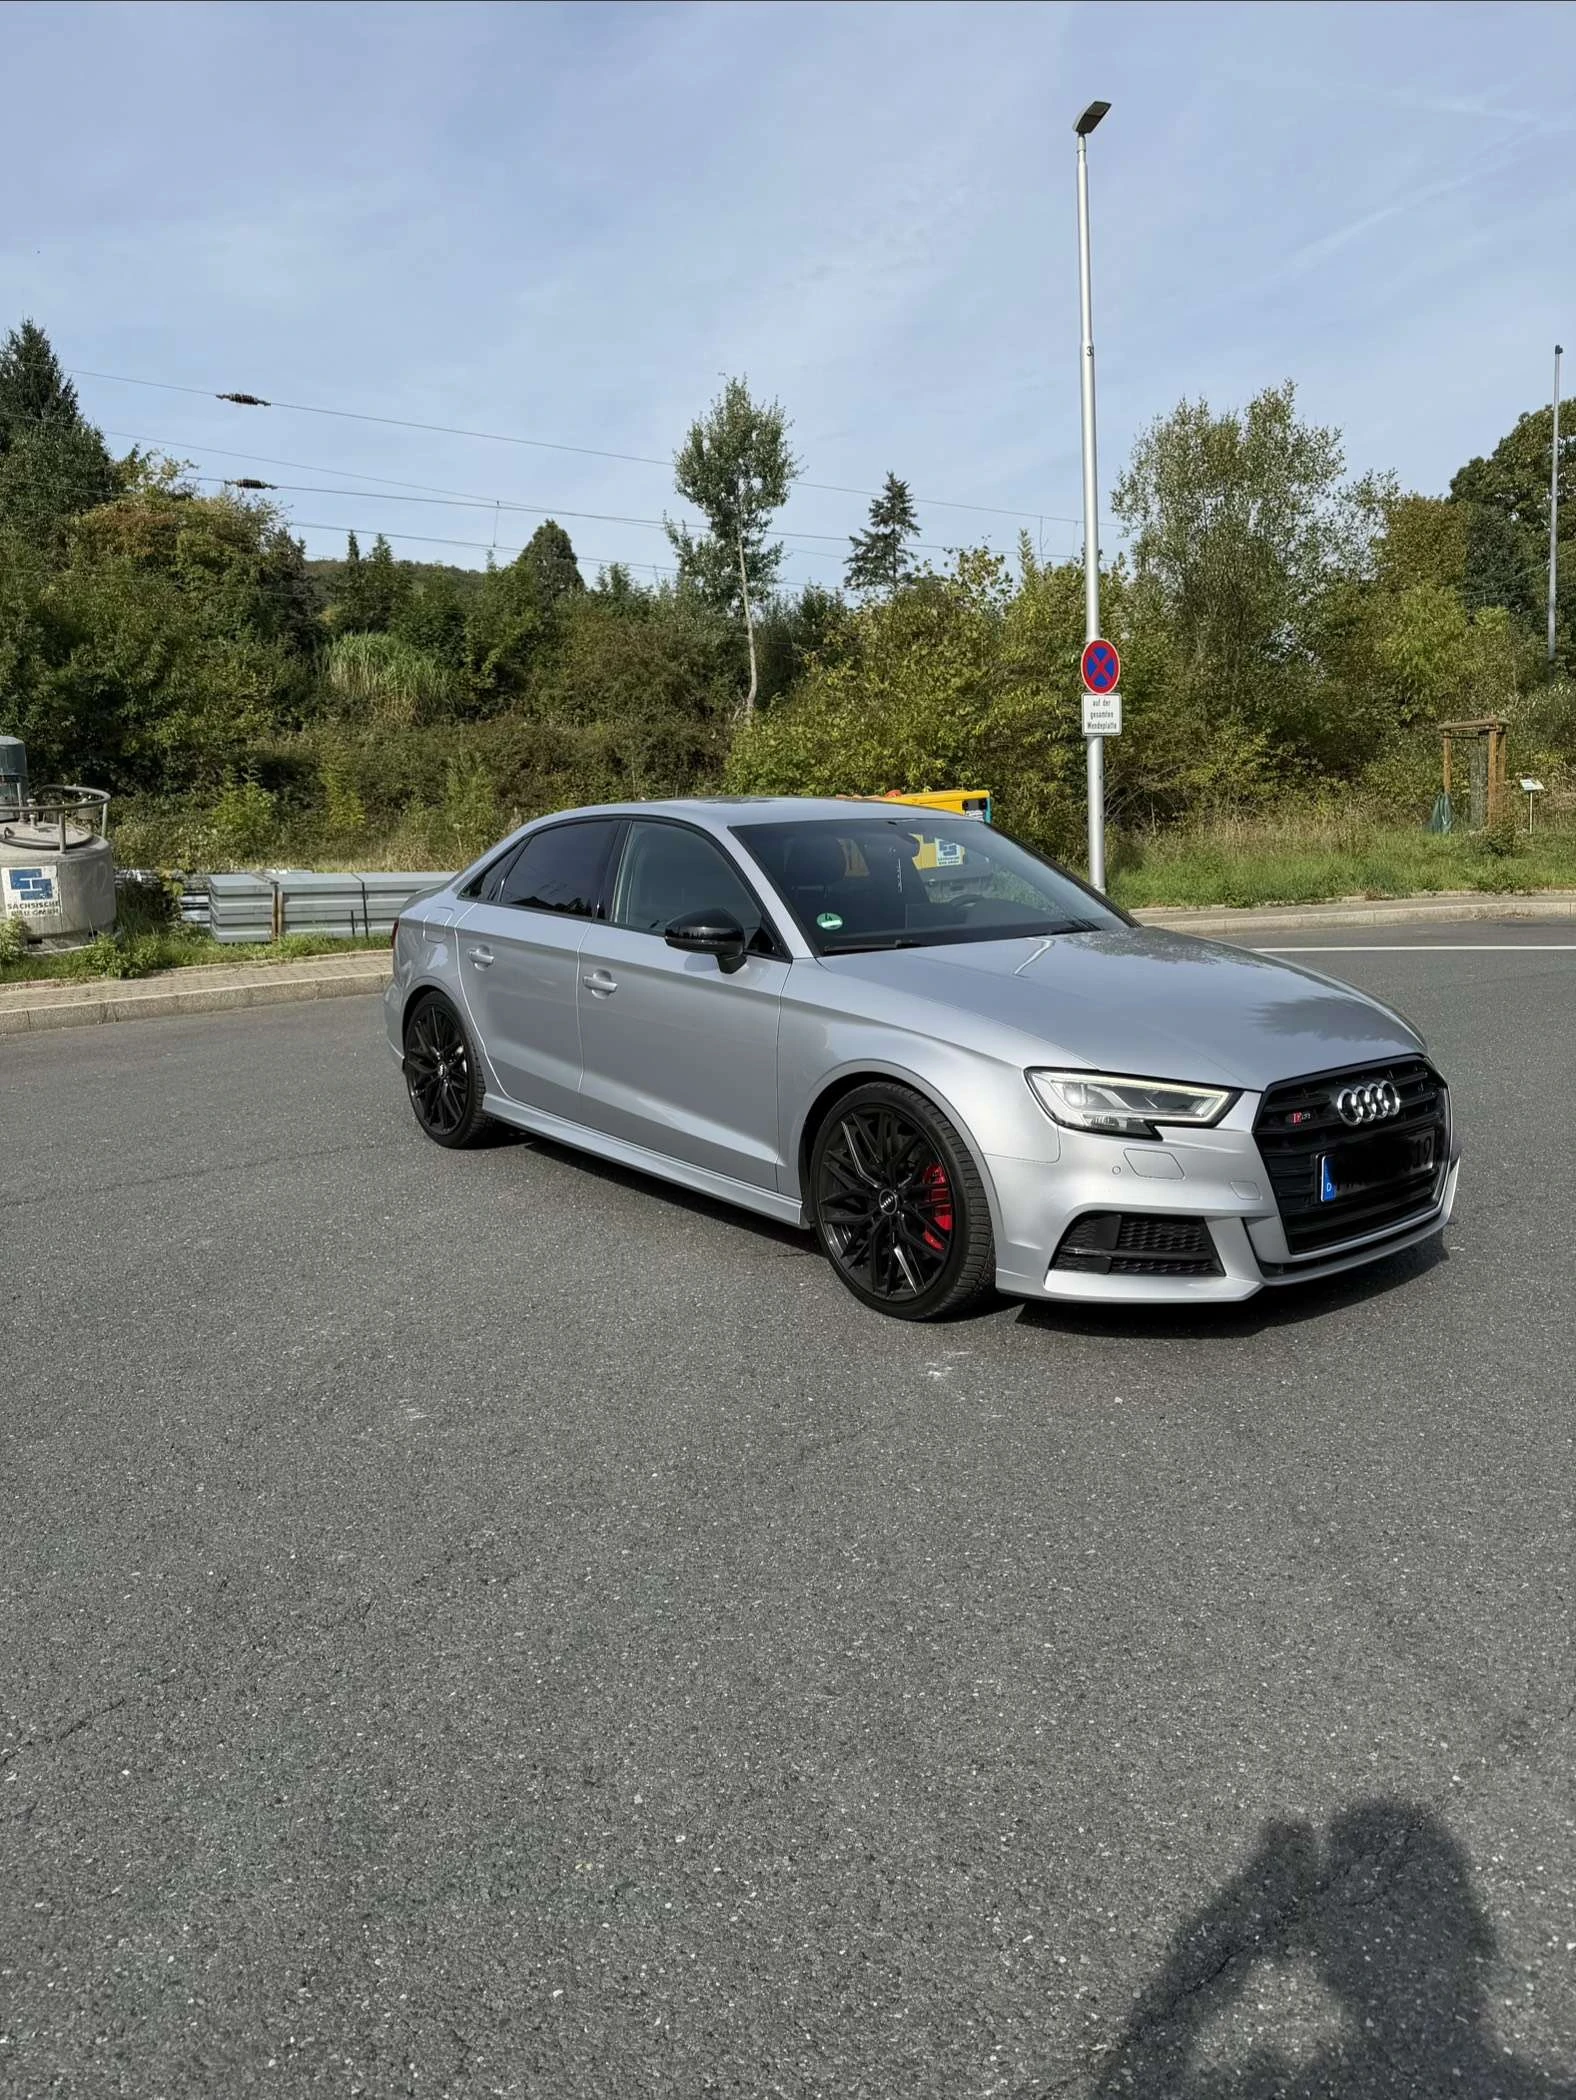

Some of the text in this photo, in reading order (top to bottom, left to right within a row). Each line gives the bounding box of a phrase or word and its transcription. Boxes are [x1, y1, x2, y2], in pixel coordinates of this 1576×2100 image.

[1093, 698, 1111, 706] auf der
[1090, 711, 1113, 720] gesamten
[1326, 1183, 1332, 1192] D
